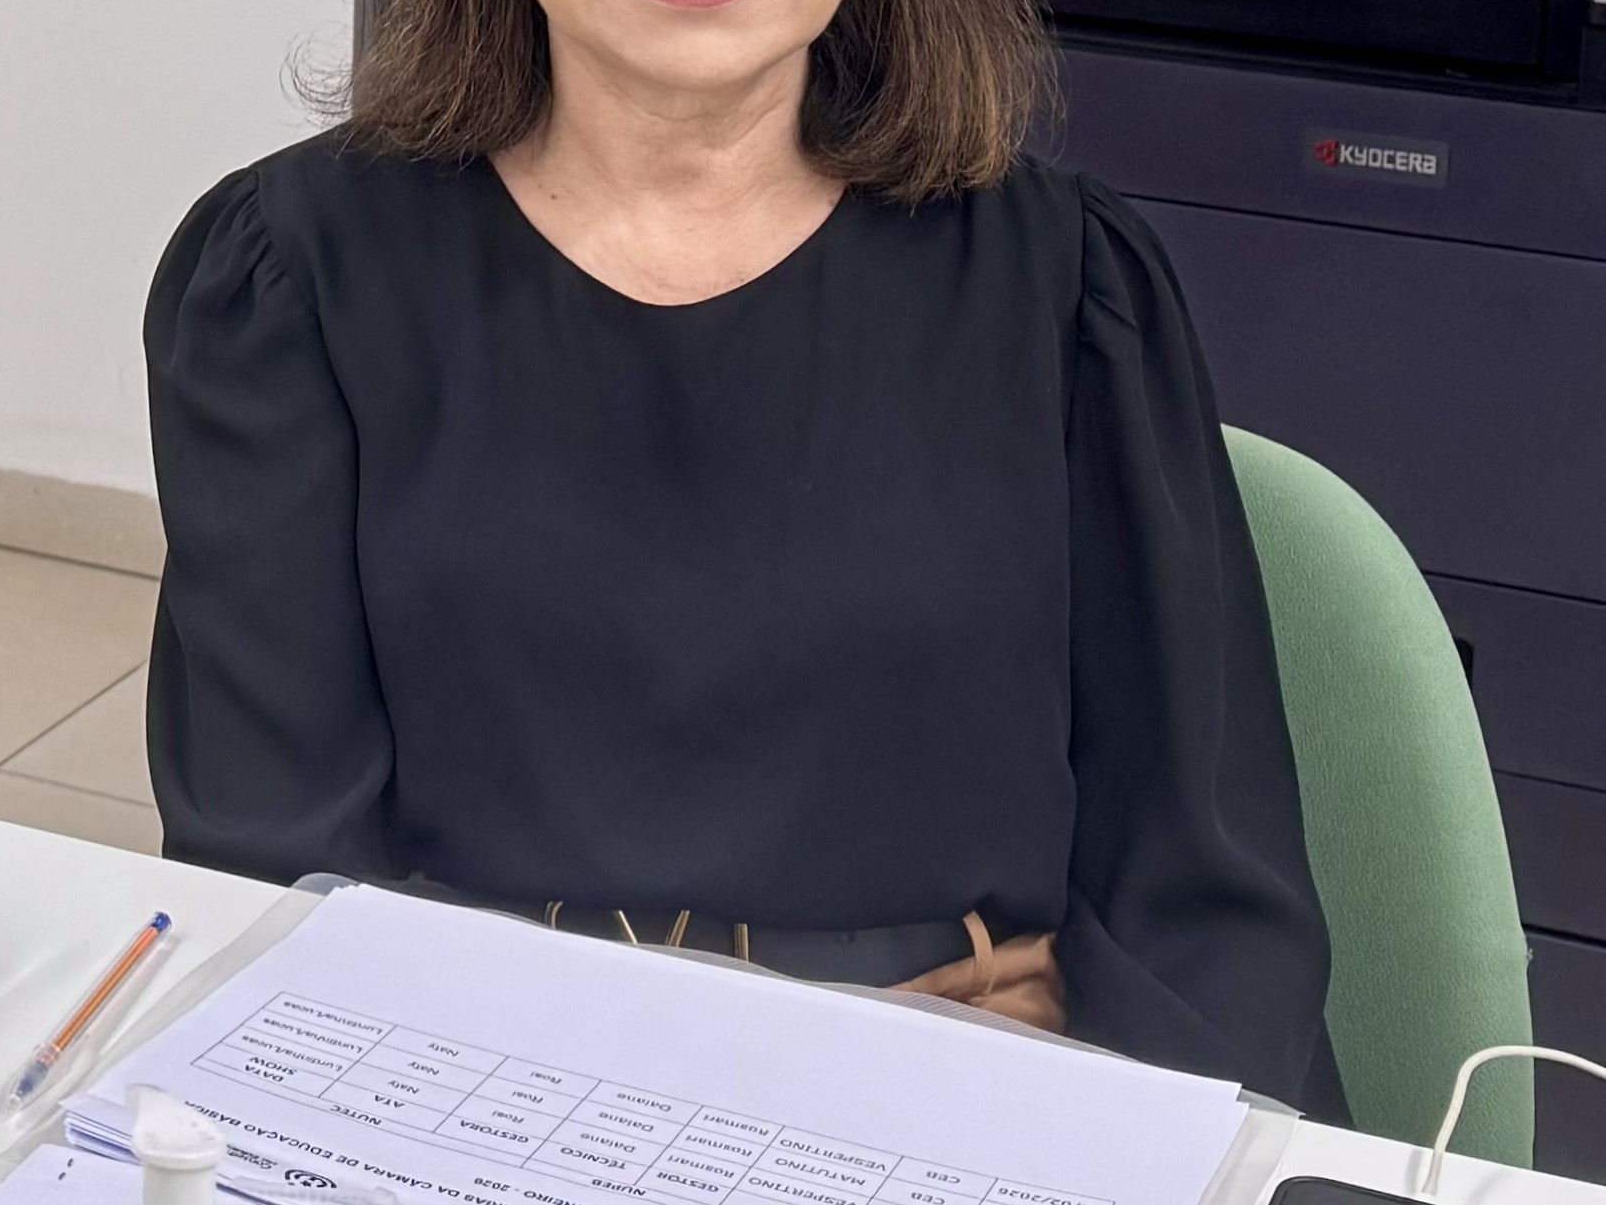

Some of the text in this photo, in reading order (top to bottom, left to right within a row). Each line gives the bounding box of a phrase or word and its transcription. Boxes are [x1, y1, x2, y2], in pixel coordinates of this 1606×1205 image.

[1340, 144, 1437, 175] KYOCERA
[244, 1065, 284, 1083] DATA
[249, 1057, 298, 1076] SHOW
[373, 1094, 406, 1109] ATA
[329, 1104, 382, 1126] NUTEC
[459, 1120, 529, 1143] GESTORA
[335, 1155, 359, 1167] DE
[779, 1138, 886, 1172] VESPERTINO
[656, 1171, 719, 1193] GESTOR
[774, 1157, 866, 1186] MATUTINO
[438, 1186, 460, 1198] DA
